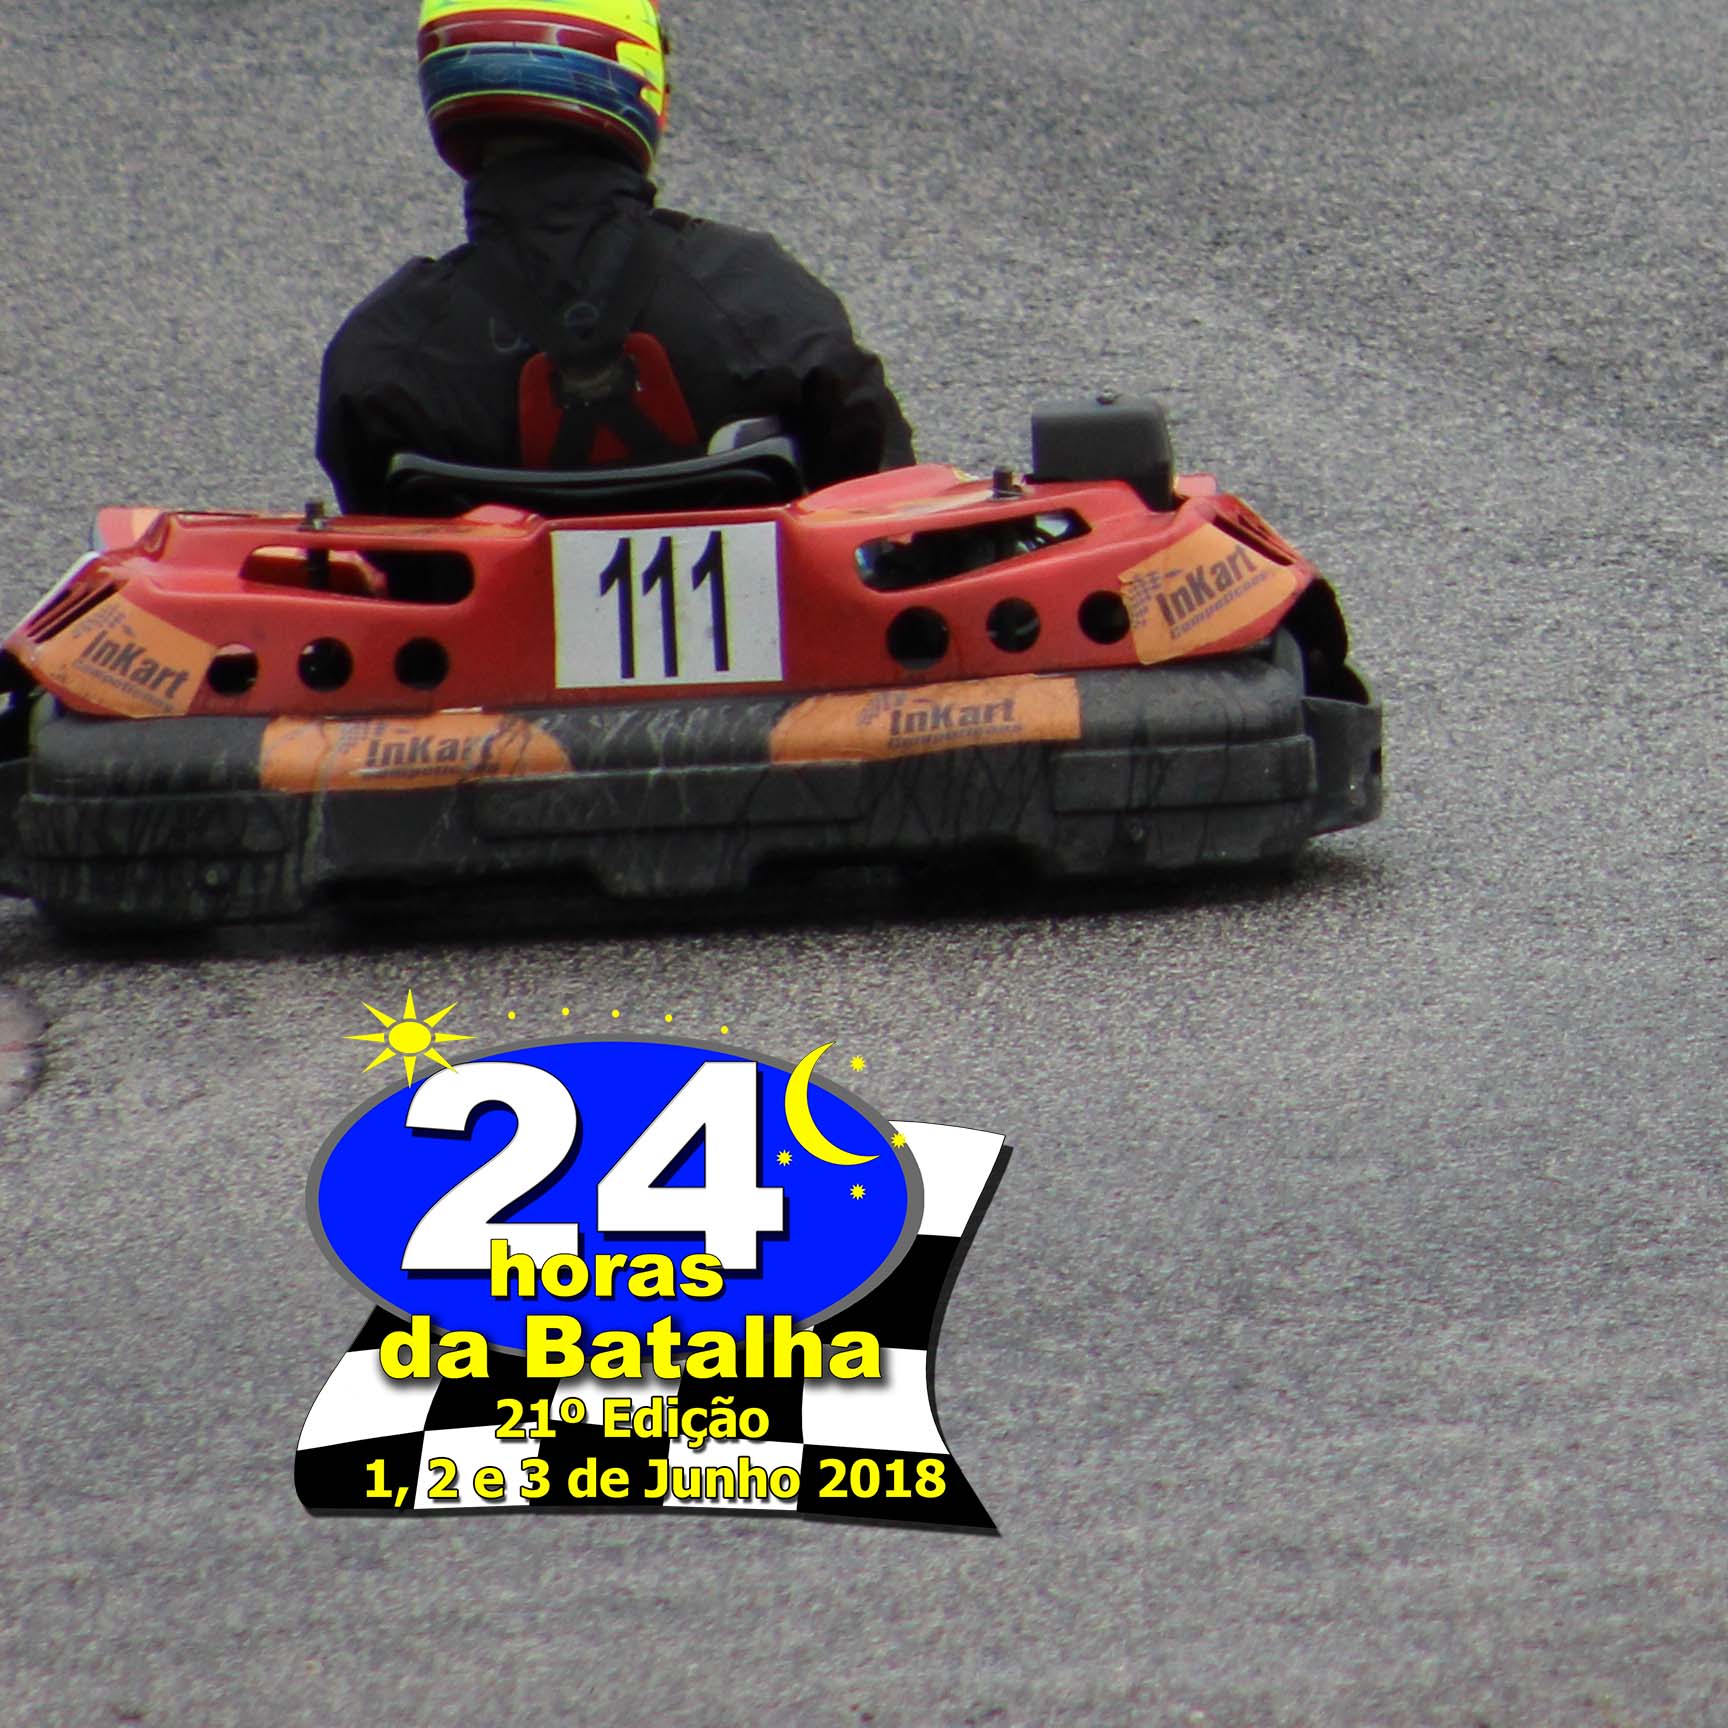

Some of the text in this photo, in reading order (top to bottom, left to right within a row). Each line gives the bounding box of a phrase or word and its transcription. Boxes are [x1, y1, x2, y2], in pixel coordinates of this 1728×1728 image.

[600, 530, 728, 680] 111
[1156, 544, 1256, 626] InKart
[81, 630, 191, 698] InKart
[889, 698, 1016, 735] InKart
